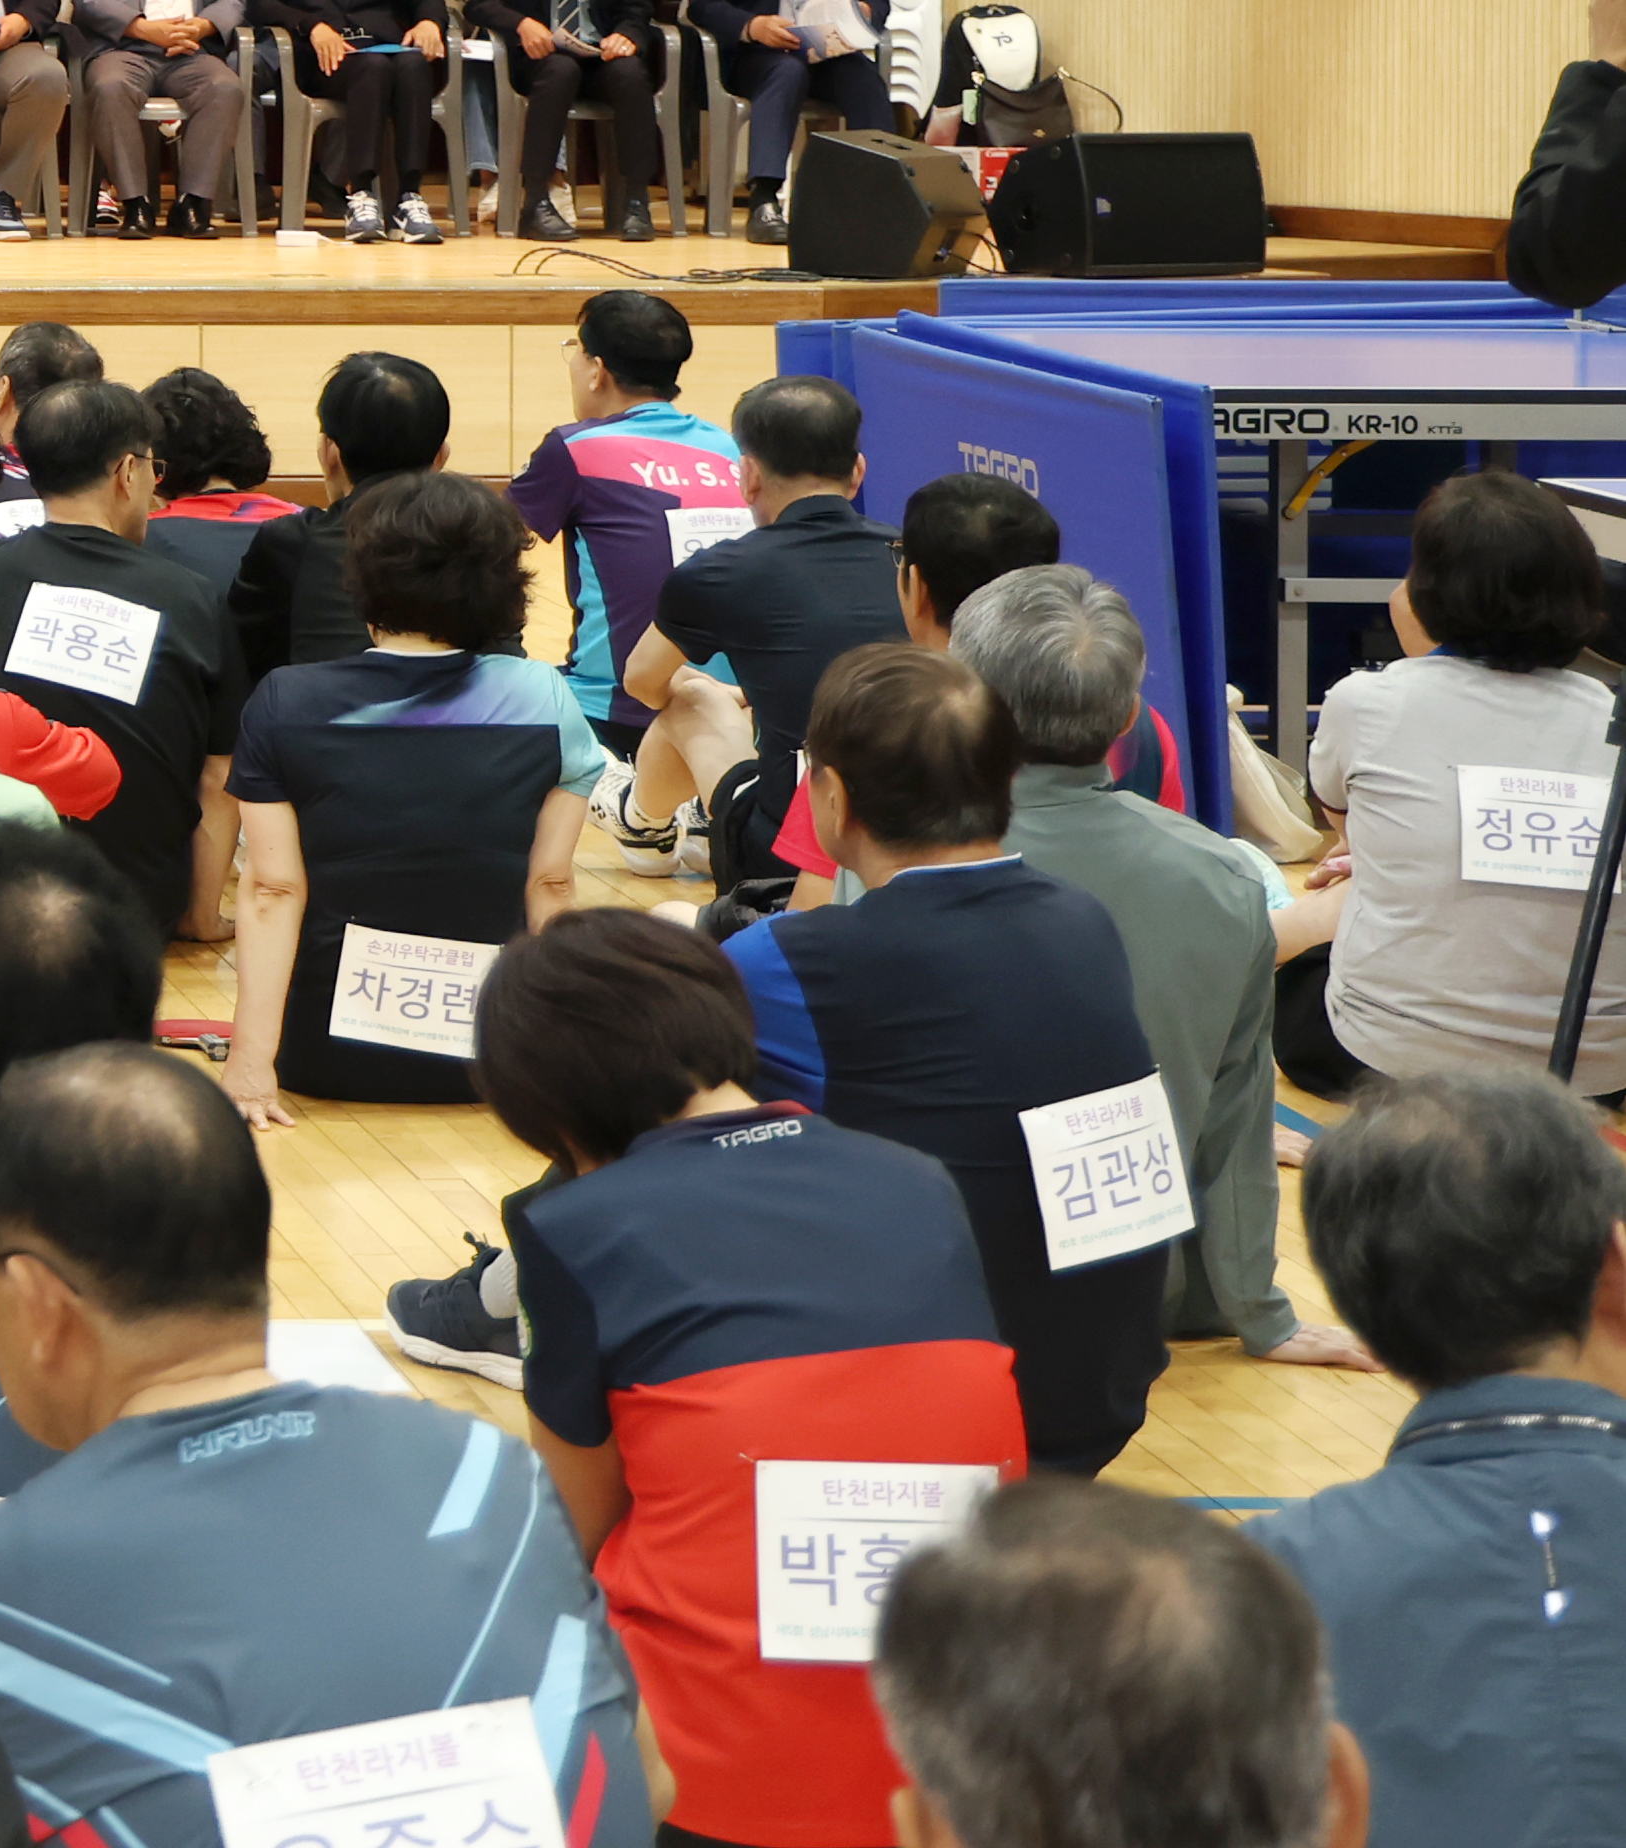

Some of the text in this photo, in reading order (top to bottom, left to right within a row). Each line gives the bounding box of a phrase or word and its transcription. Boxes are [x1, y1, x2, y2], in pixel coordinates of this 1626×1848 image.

[1214, 408, 1329, 435] AGRO
[1348, 415, 1419, 435] KR-10
[630, 460, 690, 488] Yu.
[695, 461, 728, 487] S.
[27, 616, 138, 674] 곽용순
[1500, 776, 1578, 799] 탄천라지볼
[1475, 807, 1602, 858] 정유순
[366, 938, 475, 968] 손지우탁구클럽
[1065, 1095, 1144, 1136] 탄천라지볼
[712, 1119, 803, 1150] TAGRO
[1052, 1132, 1174, 1222] 김관상
[822, 1479, 944, 1508] 탄천라지볼
[780, 1532, 911, 1607] 박홍
[298, 1732, 462, 1792] 탄천라지볼
